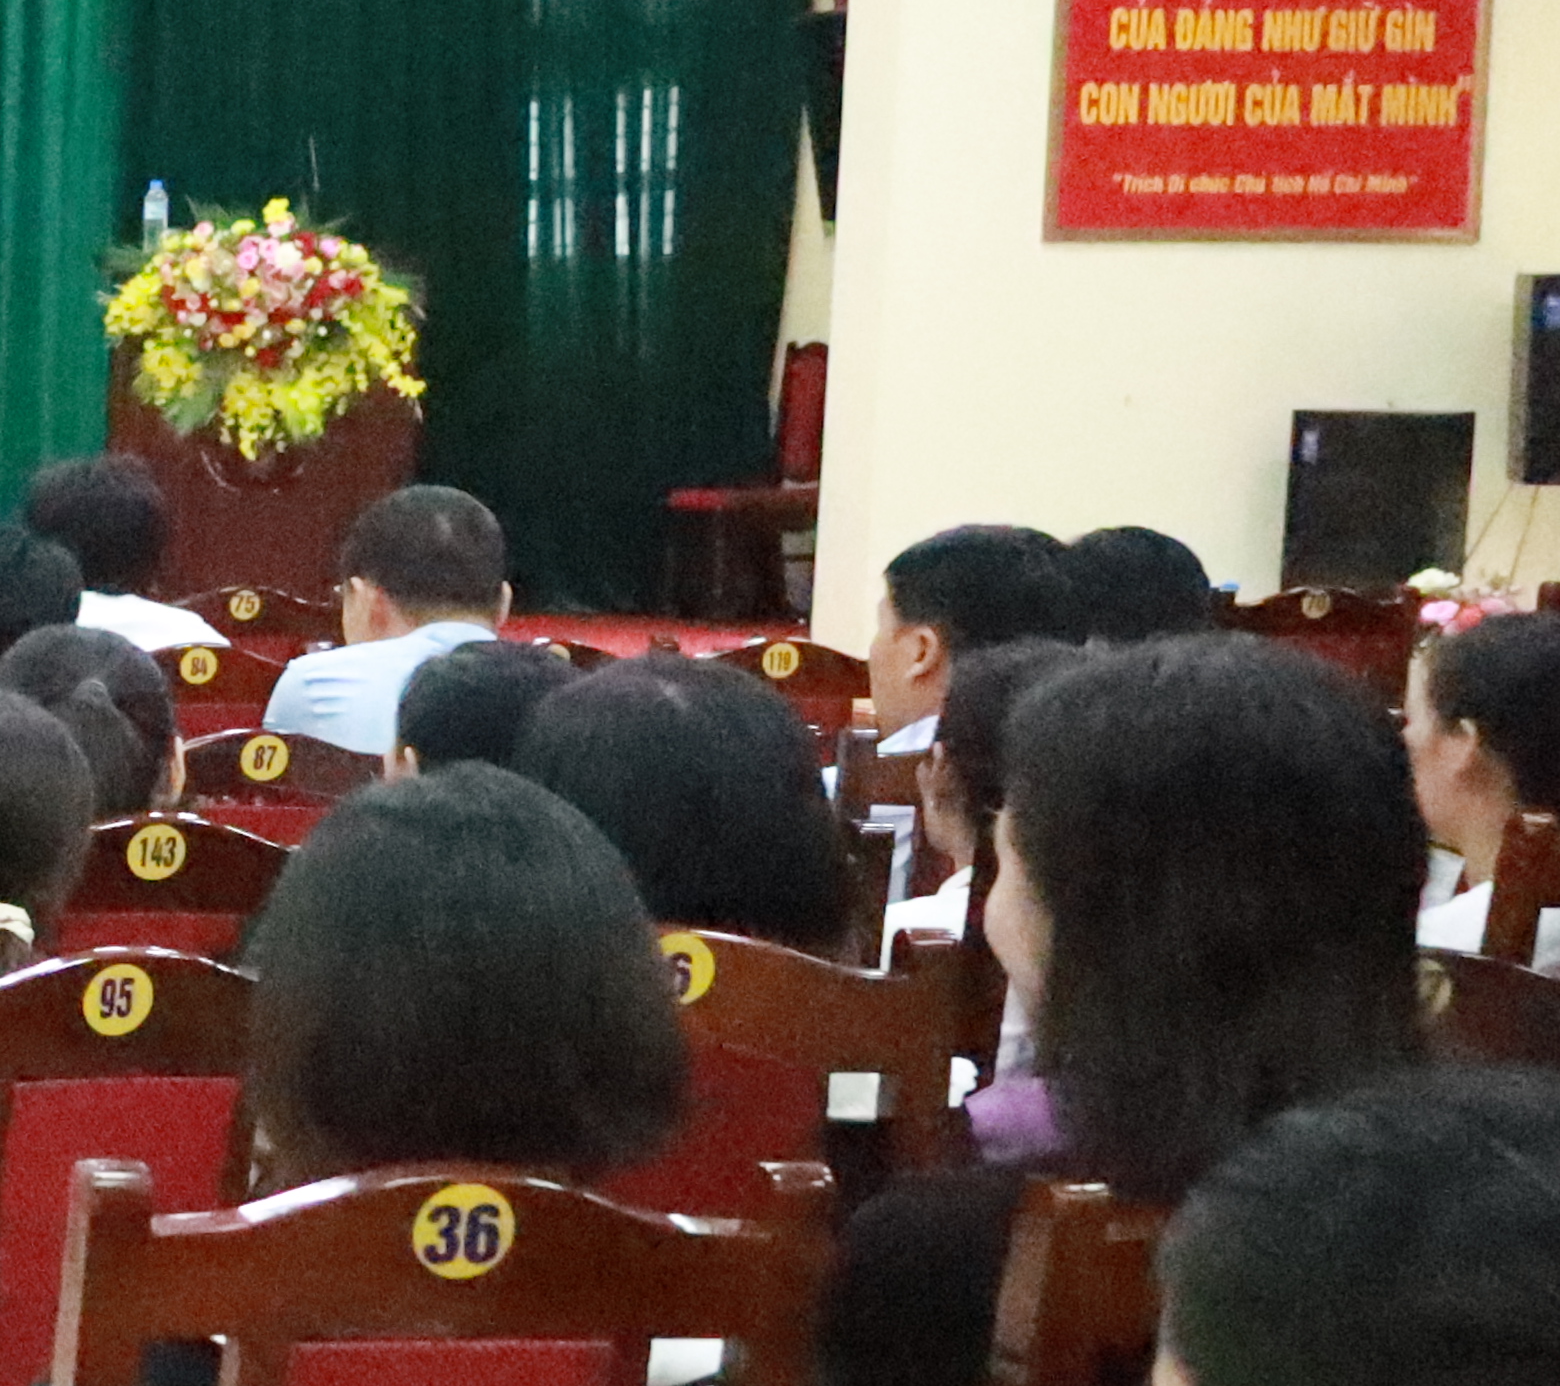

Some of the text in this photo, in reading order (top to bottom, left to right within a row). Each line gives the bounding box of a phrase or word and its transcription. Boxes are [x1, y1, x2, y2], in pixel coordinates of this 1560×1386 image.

[1262, 7, 1326, 51] NHƯ
[1327, 2, 1381, 51] GIỮ
[1080, 82, 1139, 125] CON
[1244, 70, 1300, 126] CỦA
[234, 595, 255, 613] 75
[191, 657, 207, 677] 84
[252, 747, 277, 769] 87
[139, 838, 176, 866] 143
[100, 978, 132, 1019] 95
[424, 1207, 501, 1264] 36
